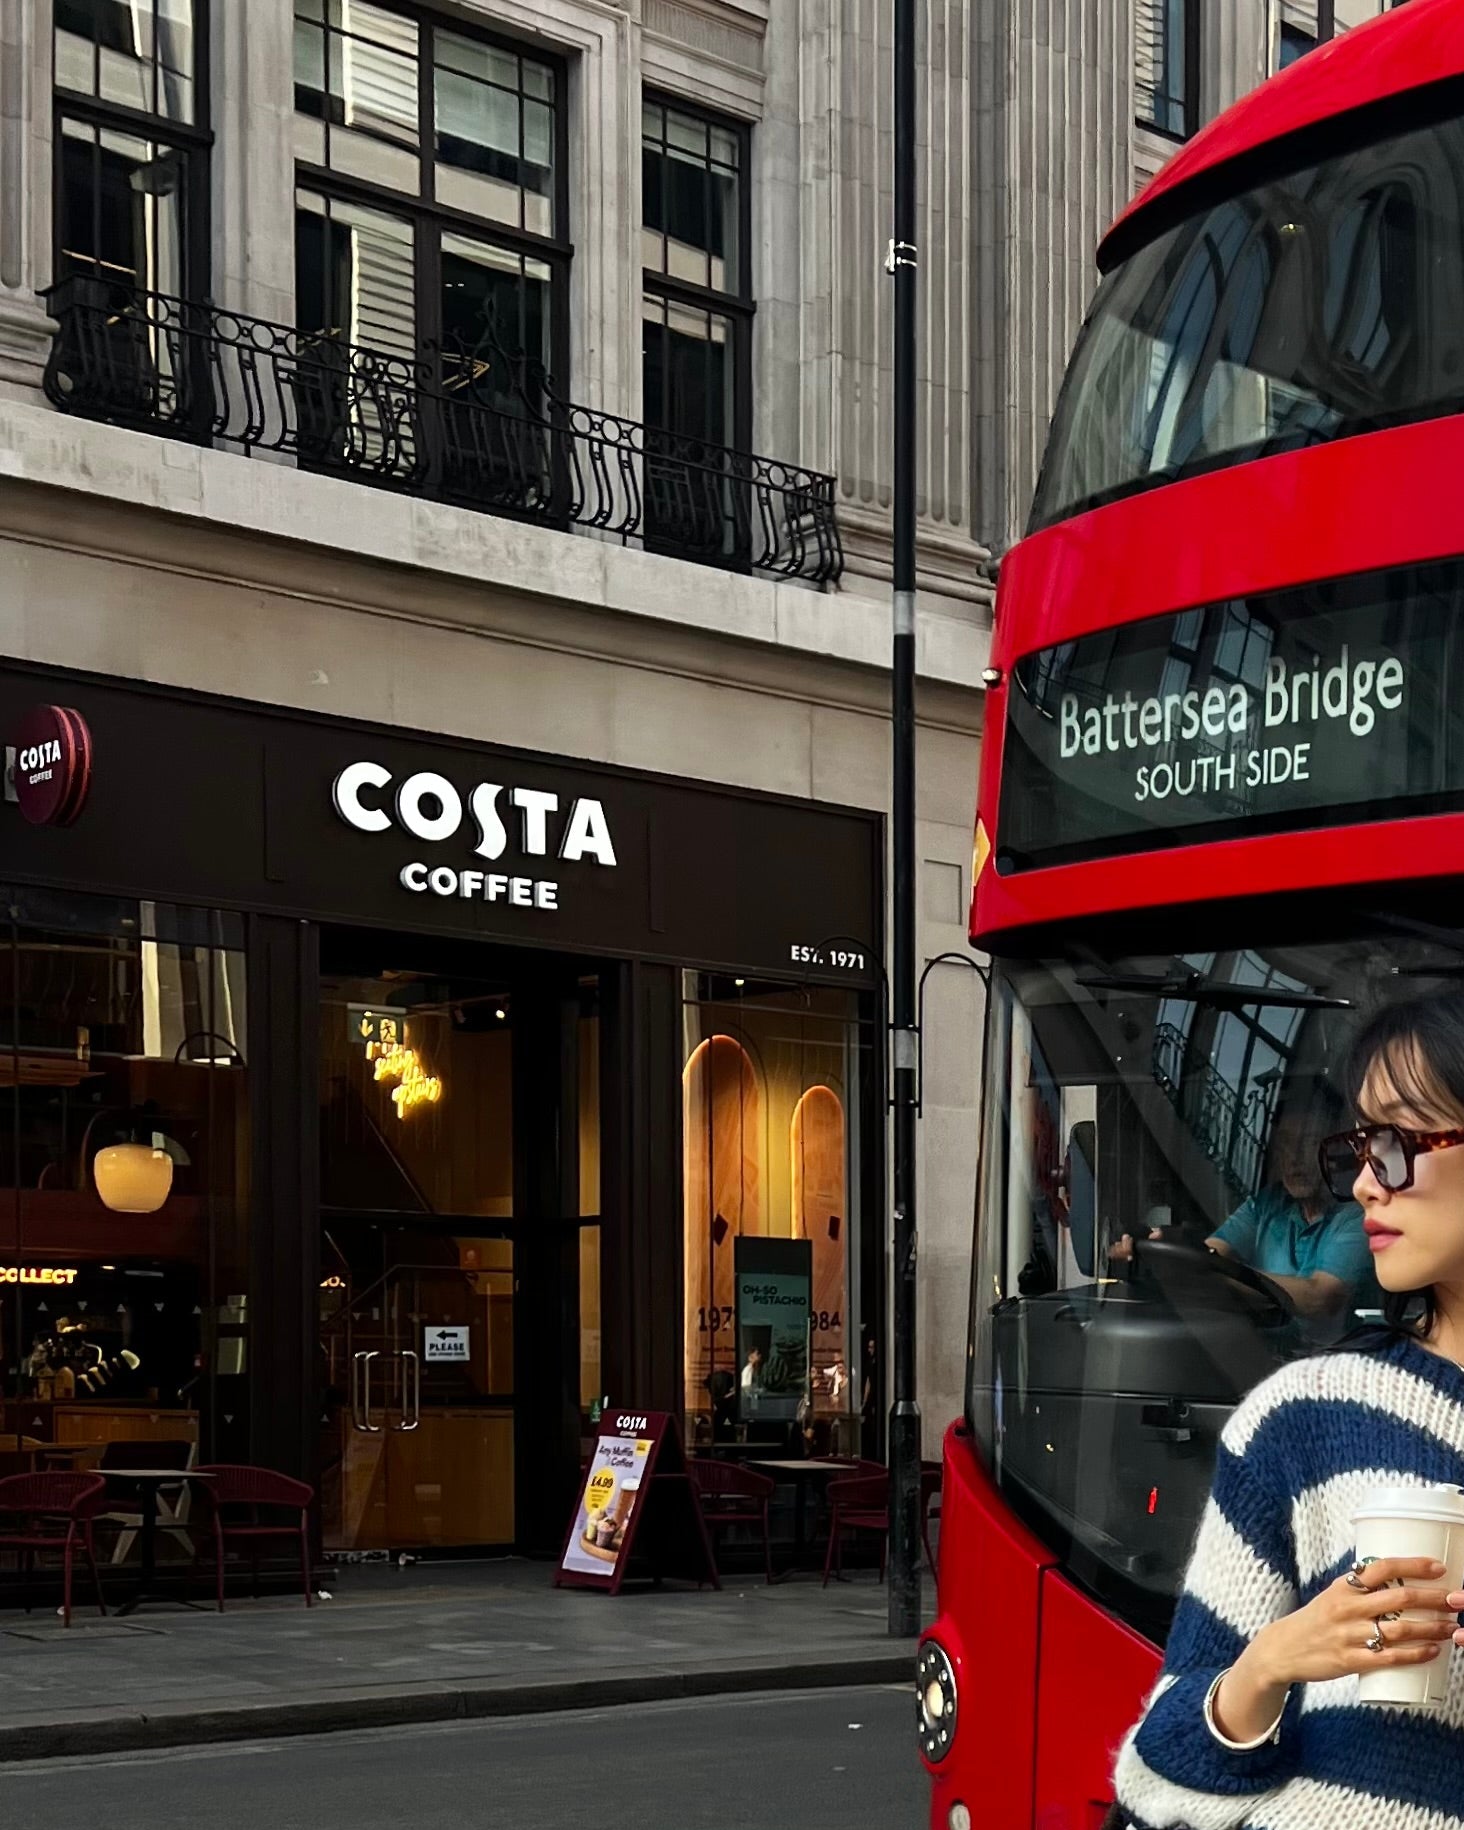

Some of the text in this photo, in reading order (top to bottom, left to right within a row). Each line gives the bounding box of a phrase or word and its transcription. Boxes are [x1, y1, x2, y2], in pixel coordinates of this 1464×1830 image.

[1060, 644, 1404, 758] Battersea Bridge
[19, 739, 62, 772] COSTA
[1134, 743, 1311, 801] SOUTH SIDE
[332, 761, 617, 867] COSTA
[400, 862, 558, 910] COFFEE
[791, 944, 865, 970] EST. 1971
[753, 1295, 807, 1306] PISTACHIO
[698, 1306, 735, 1332] 197
[810, 1310, 841, 1332] 984
[429, 1343, 464, 1351] PLEASE
[616, 1415, 647, 1430] COSTA
